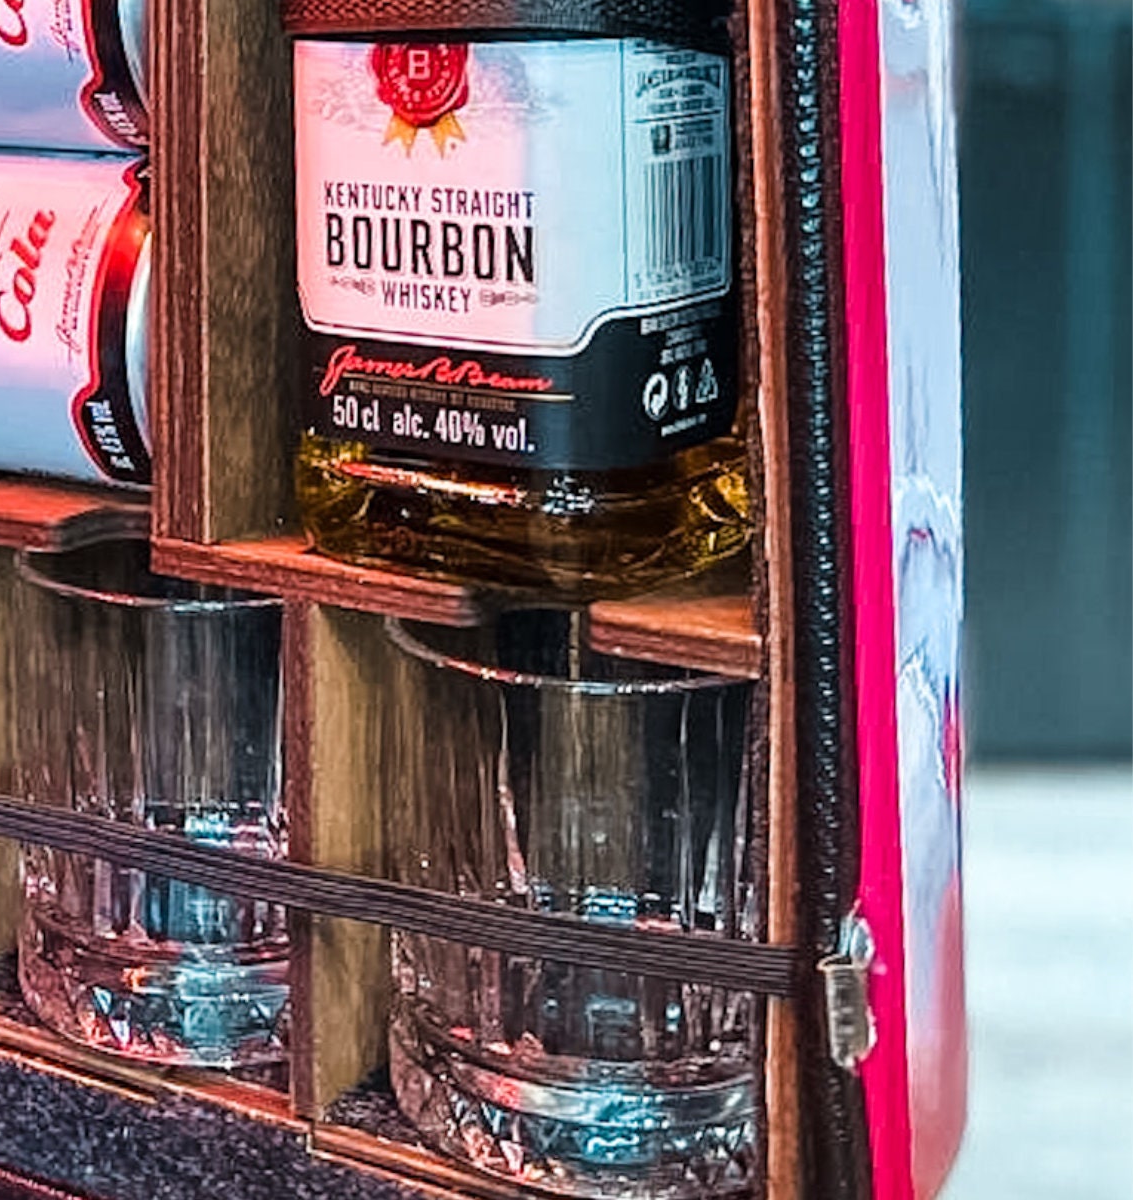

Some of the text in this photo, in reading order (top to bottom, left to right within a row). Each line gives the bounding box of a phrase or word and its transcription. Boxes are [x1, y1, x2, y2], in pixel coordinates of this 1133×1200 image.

[408, 49, 431, 80] B
[324, 181, 535, 219] KENTUCKY STRAIGHT
[326, 212, 535, 283] BOURBON
[381, 280, 472, 314] WHISKEY
[392, 404, 430, 440] alc.
[434, 408, 485, 447] 40%
[491, 417, 537, 453] vol.
